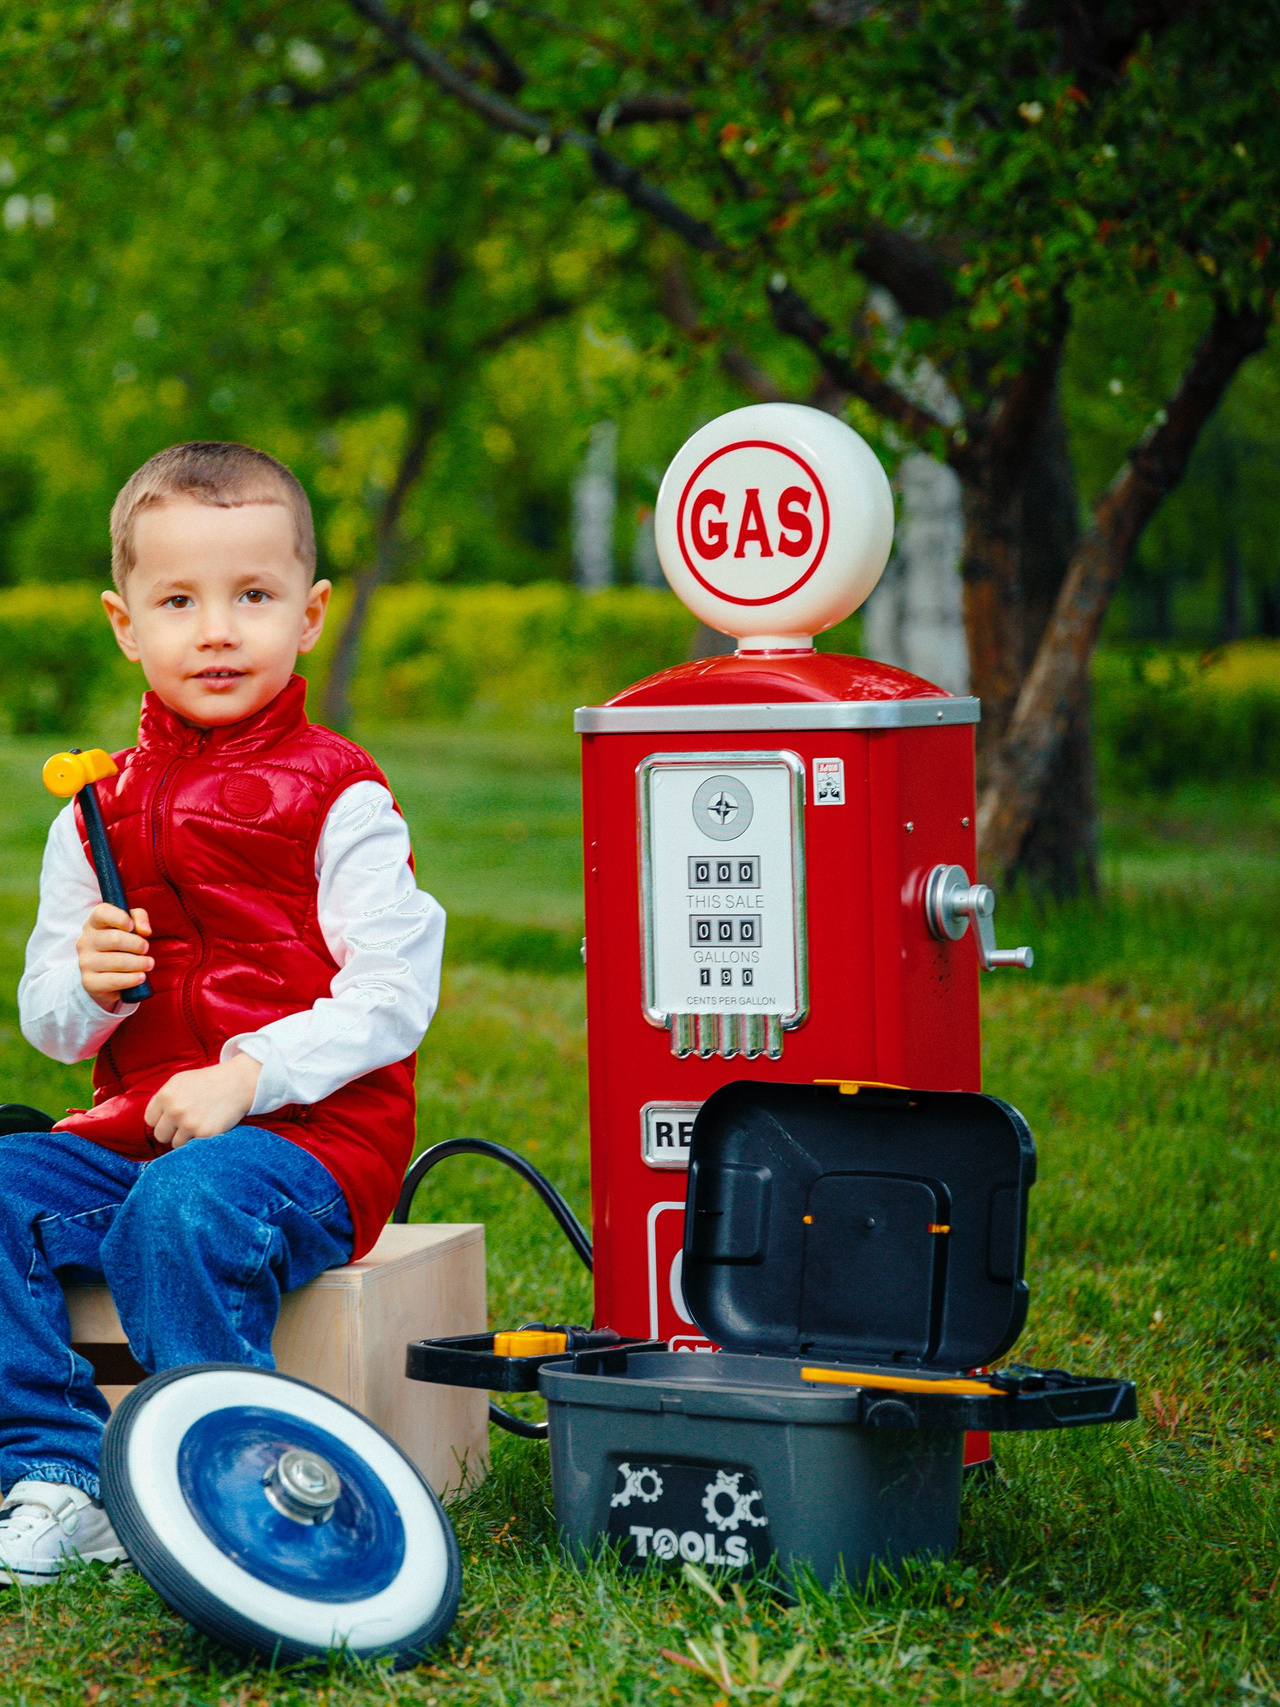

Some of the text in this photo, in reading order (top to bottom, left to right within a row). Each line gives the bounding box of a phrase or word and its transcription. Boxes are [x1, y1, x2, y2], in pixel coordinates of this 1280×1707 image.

[690, 485, 813, 560] GAS
[686, 894, 764, 909] THIS SALE
[694, 950, 760, 963] GALLONS
[687, 996, 776, 1006] CENTS PER GALLON
[629, 1525, 749, 1568] TOOLS
